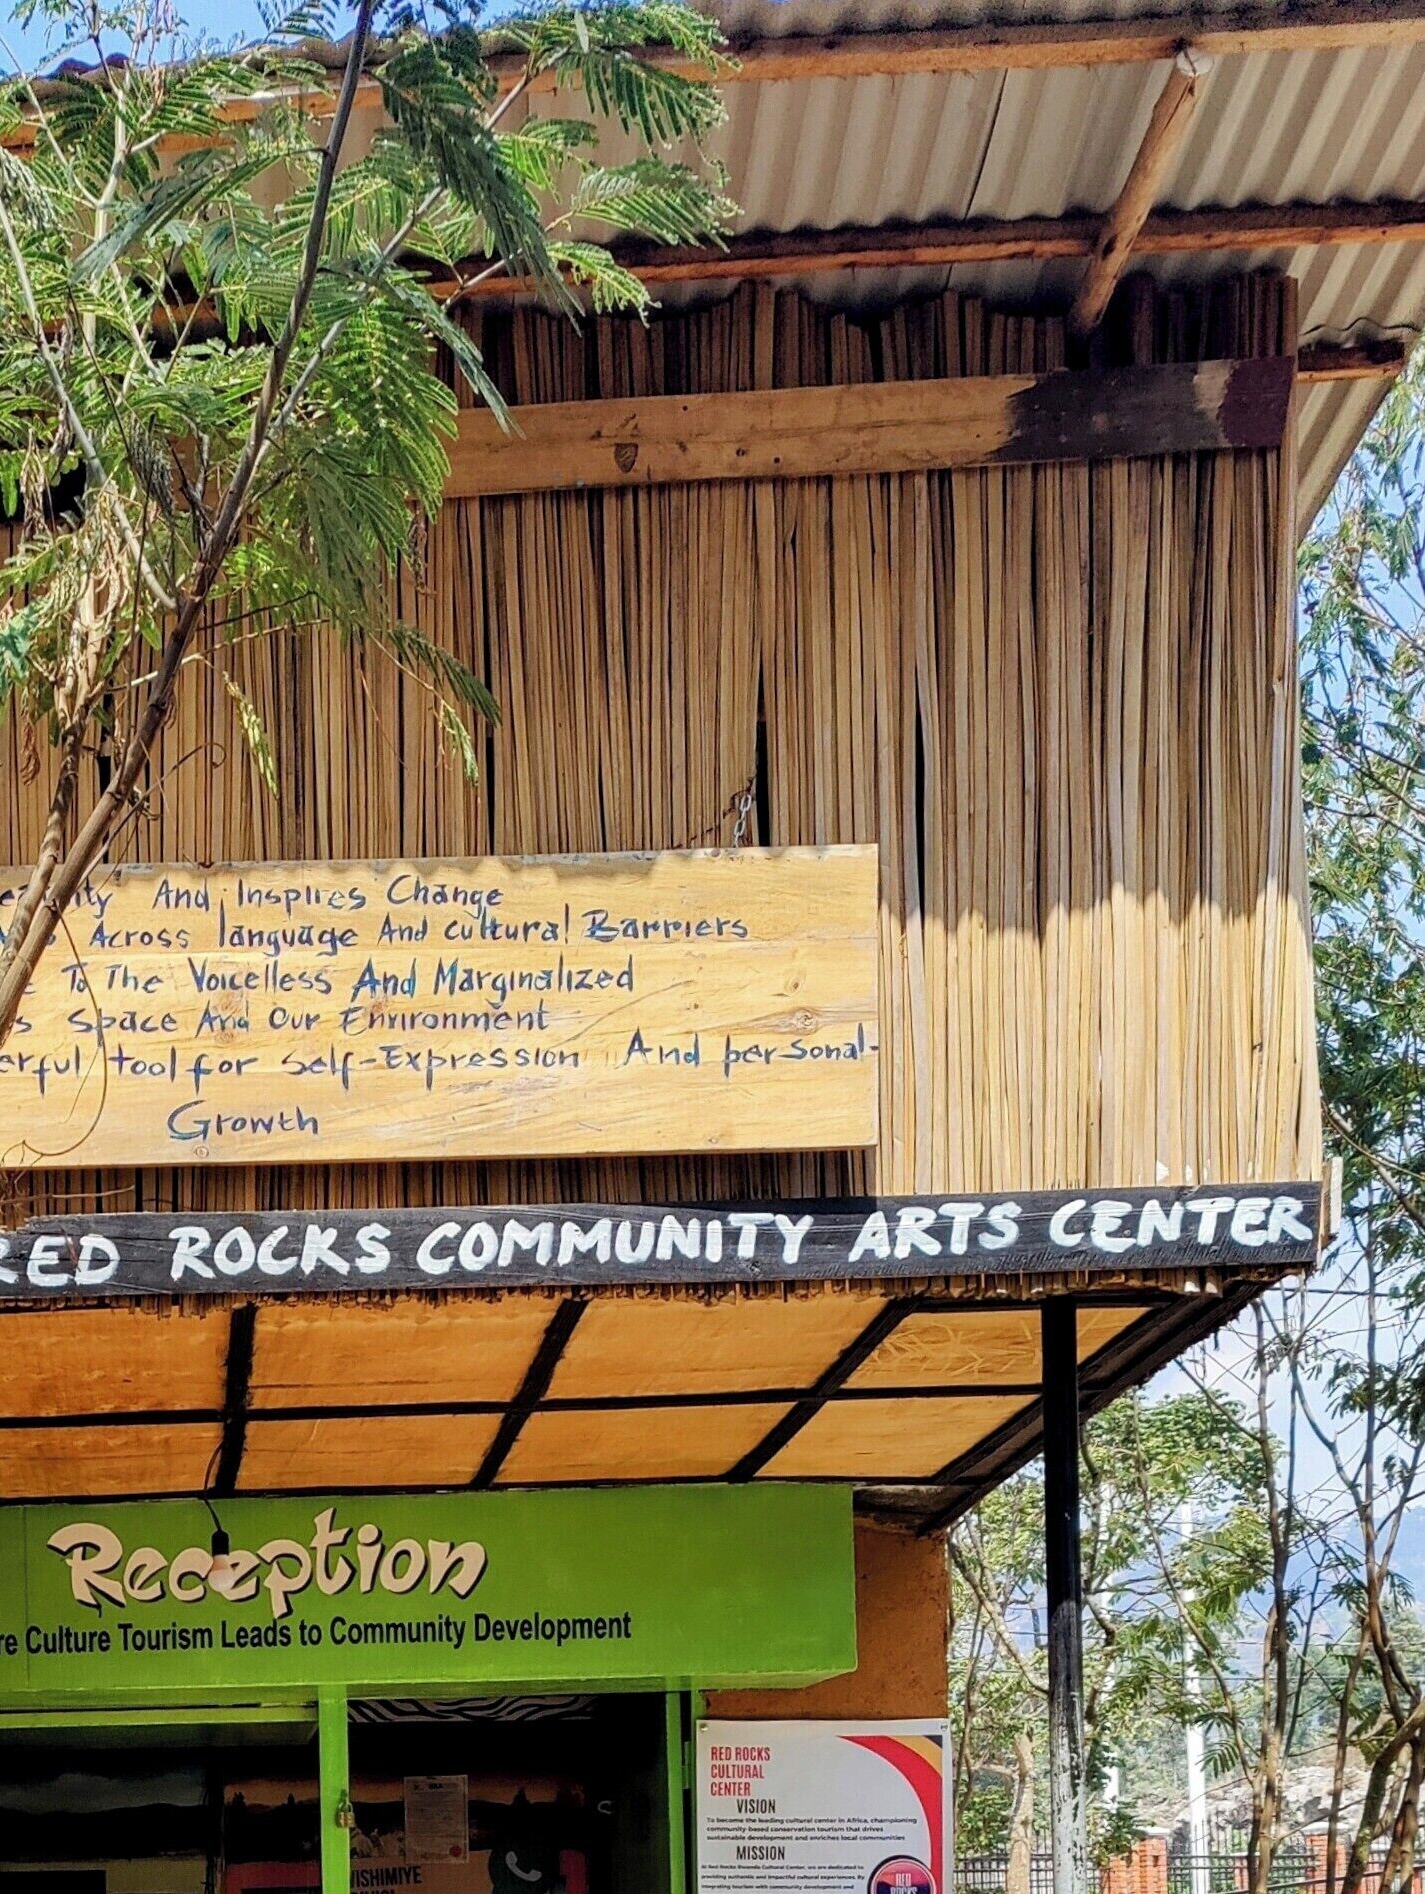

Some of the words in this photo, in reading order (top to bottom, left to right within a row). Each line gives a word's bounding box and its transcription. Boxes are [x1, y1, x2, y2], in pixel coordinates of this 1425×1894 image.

[152, 877, 210, 912] And
[387, 874, 504, 918] Change
[89, 920, 191, 949] Across
[377, 912, 429, 945] And
[581, 908, 749, 944] Barriers
[61, 962, 89, 994] To
[105, 963, 164, 994] The
[187, 957, 333, 996] Voiceless
[351, 957, 418, 1000] And
[433, 954, 634, 1009] Marginalized
[195, 1000, 250, 1039] And
[269, 1006, 321, 1031] Our
[338, 998, 551, 1037] Environment
[108, 1043, 177, 1084] tool
[186, 1053, 259, 1096] for
[617, 1026, 701, 1069] And
[166, 1099, 319, 1142] Growth
[168, 1222, 391, 1281] ROCKS
[416, 1212, 814, 1275] COMMUNITY
[847, 1200, 1024, 1263] ARTS
[1048, 1196, 1313, 1254] CENTER
[46, 1507, 491, 1619] Reception
[25, 1624, 111, 1654] Culture
[117, 1621, 214, 1651] Tourism
[221, 1616, 292, 1649] Leads
[298, 1619, 322, 1647] to
[329, 1614, 466, 1650] Community
[474, 1610, 632, 1646] Development
[710, 1746, 732, 1761] RED
[735, 1746, 771, 1761] ROCKS
[710, 1764, 765, 1779] CULTURAL
[710, 1782, 751, 1796] CENTER
[736, 1799, 776, 1814] VISION
[736, 1846, 786, 1861] MISSION
